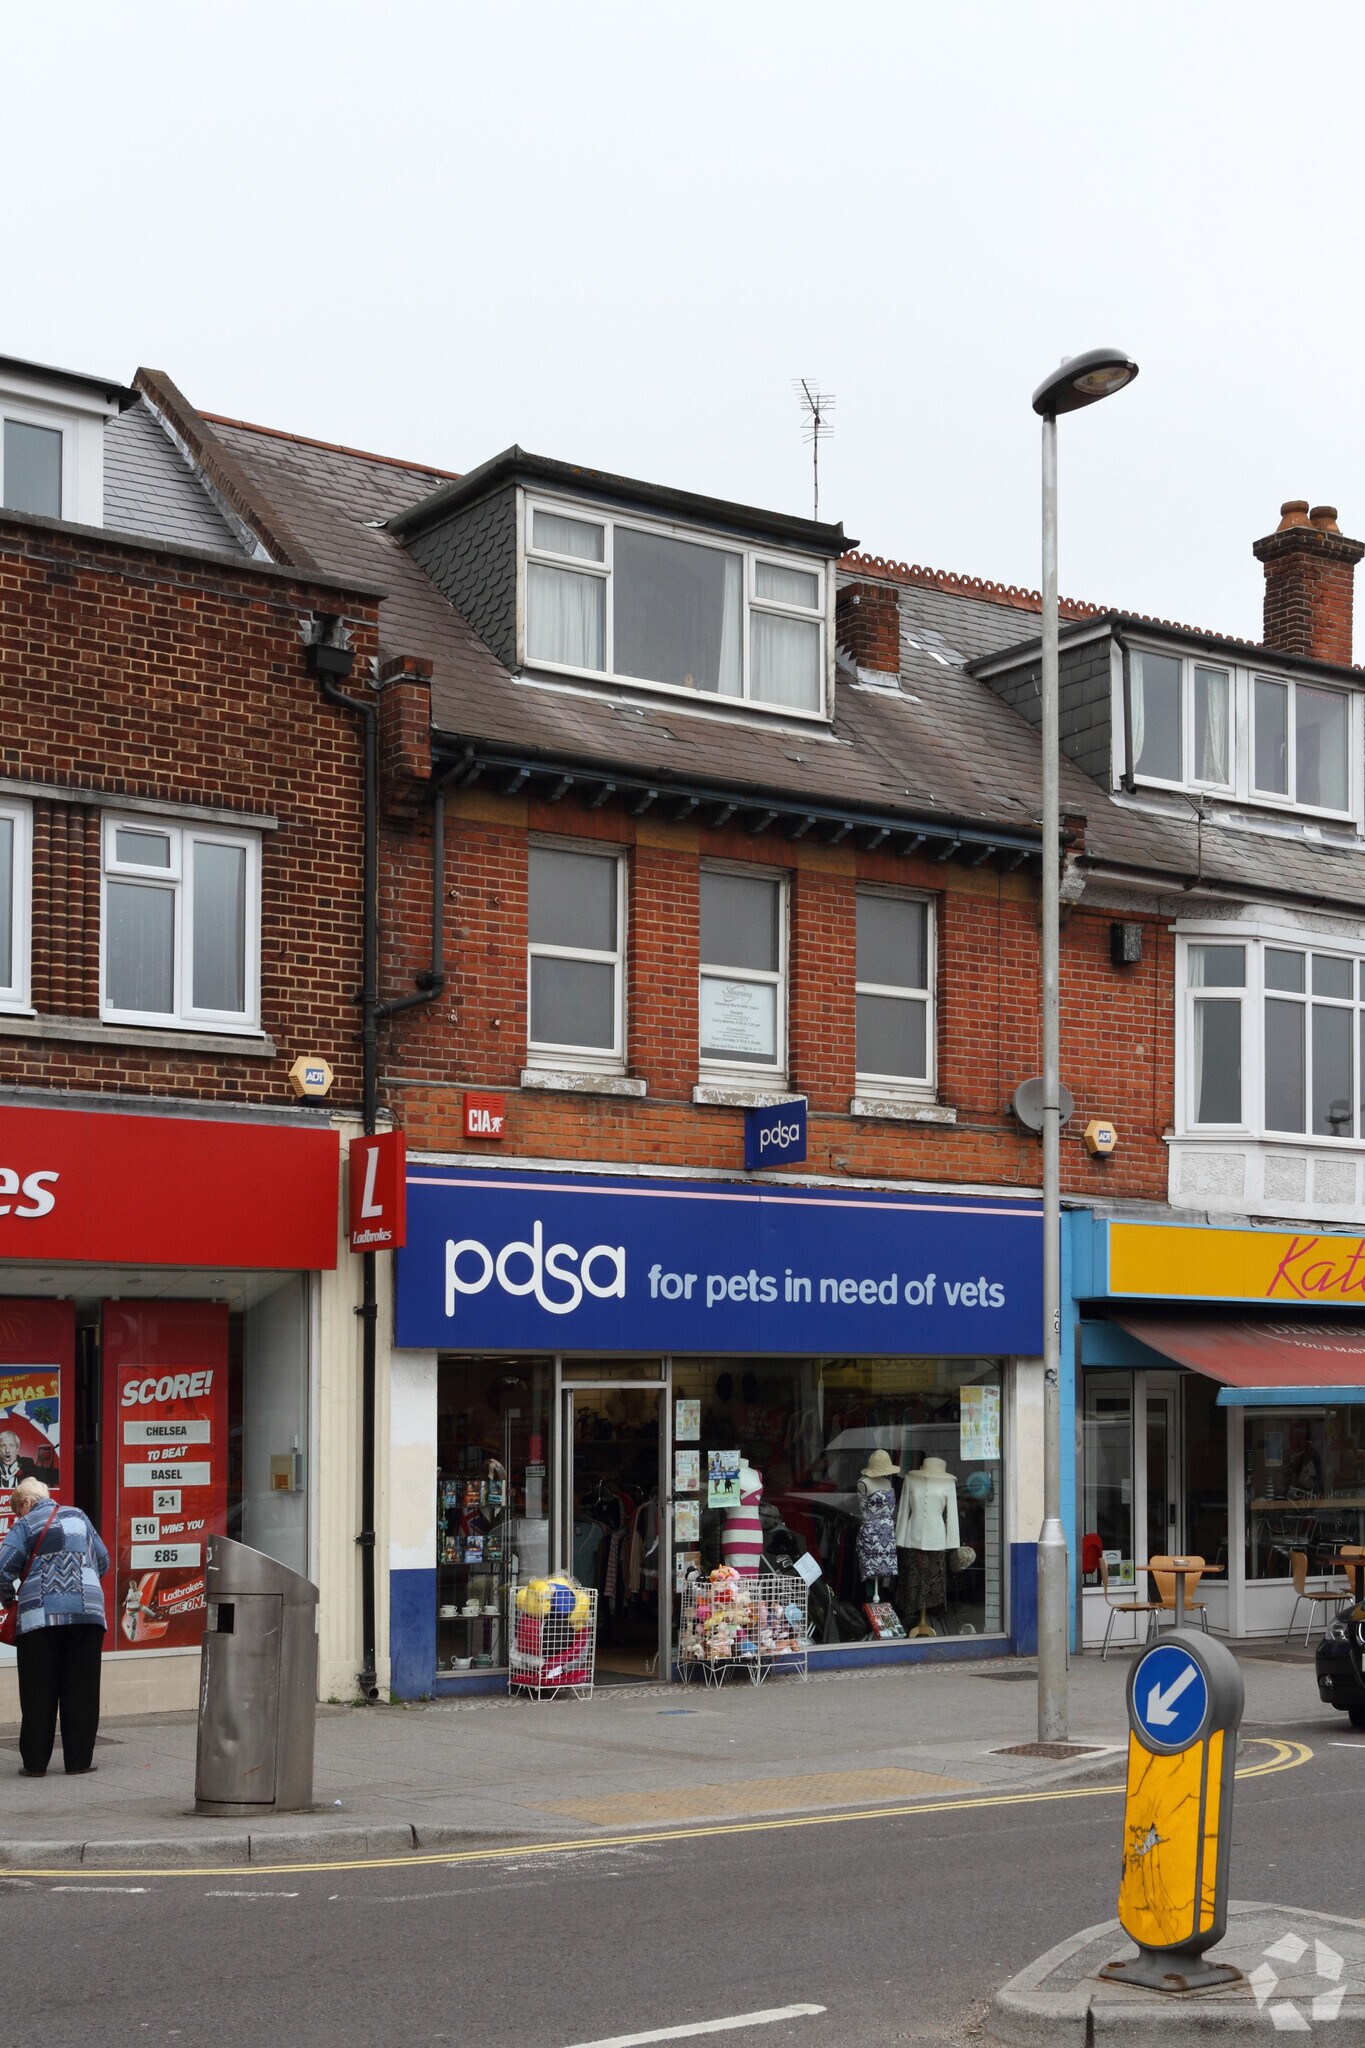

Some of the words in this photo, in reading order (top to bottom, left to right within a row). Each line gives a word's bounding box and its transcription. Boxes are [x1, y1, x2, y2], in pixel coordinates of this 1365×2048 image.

[306, 1071, 324, 1082] ADT
[469, 1109, 491, 1132] CIA
[760, 1120, 799, 1153] pdsa
[361, 1147, 383, 1218] L
[353, 1227, 393, 1244] Ladbrokes
[445, 1219, 626, 1317] pdsa
[648, 1264, 698, 1299] for
[706, 1269, 778, 1308] pets
[784, 1268, 812, 1303] in
[819, 1273, 898, 1304] need
[904, 1273, 937, 1305] of
[943, 1276, 1006, 1307] vets
[1293, 1340, 1333, 1351] YOUR
[0, 1385, 46, 1402] AMAS
[121, 1370, 213, 1407] SCORE!
[146, 1426, 187, 1436] CHELSEA
[147, 1451, 160, 1461] TO
[161, 1446, 188, 1459] BEAT
[151, 1470, 182, 1480] BASEL
[158, 1496, 175, 1507] 2-1
[135, 1524, 155, 1535] £10
[161, 1523, 184, 1535] WINS
[187, 1519, 205, 1531] YOU
[154, 1550, 178, 1562] £85
[163, 1580, 204, 1602] Ladbrokes
